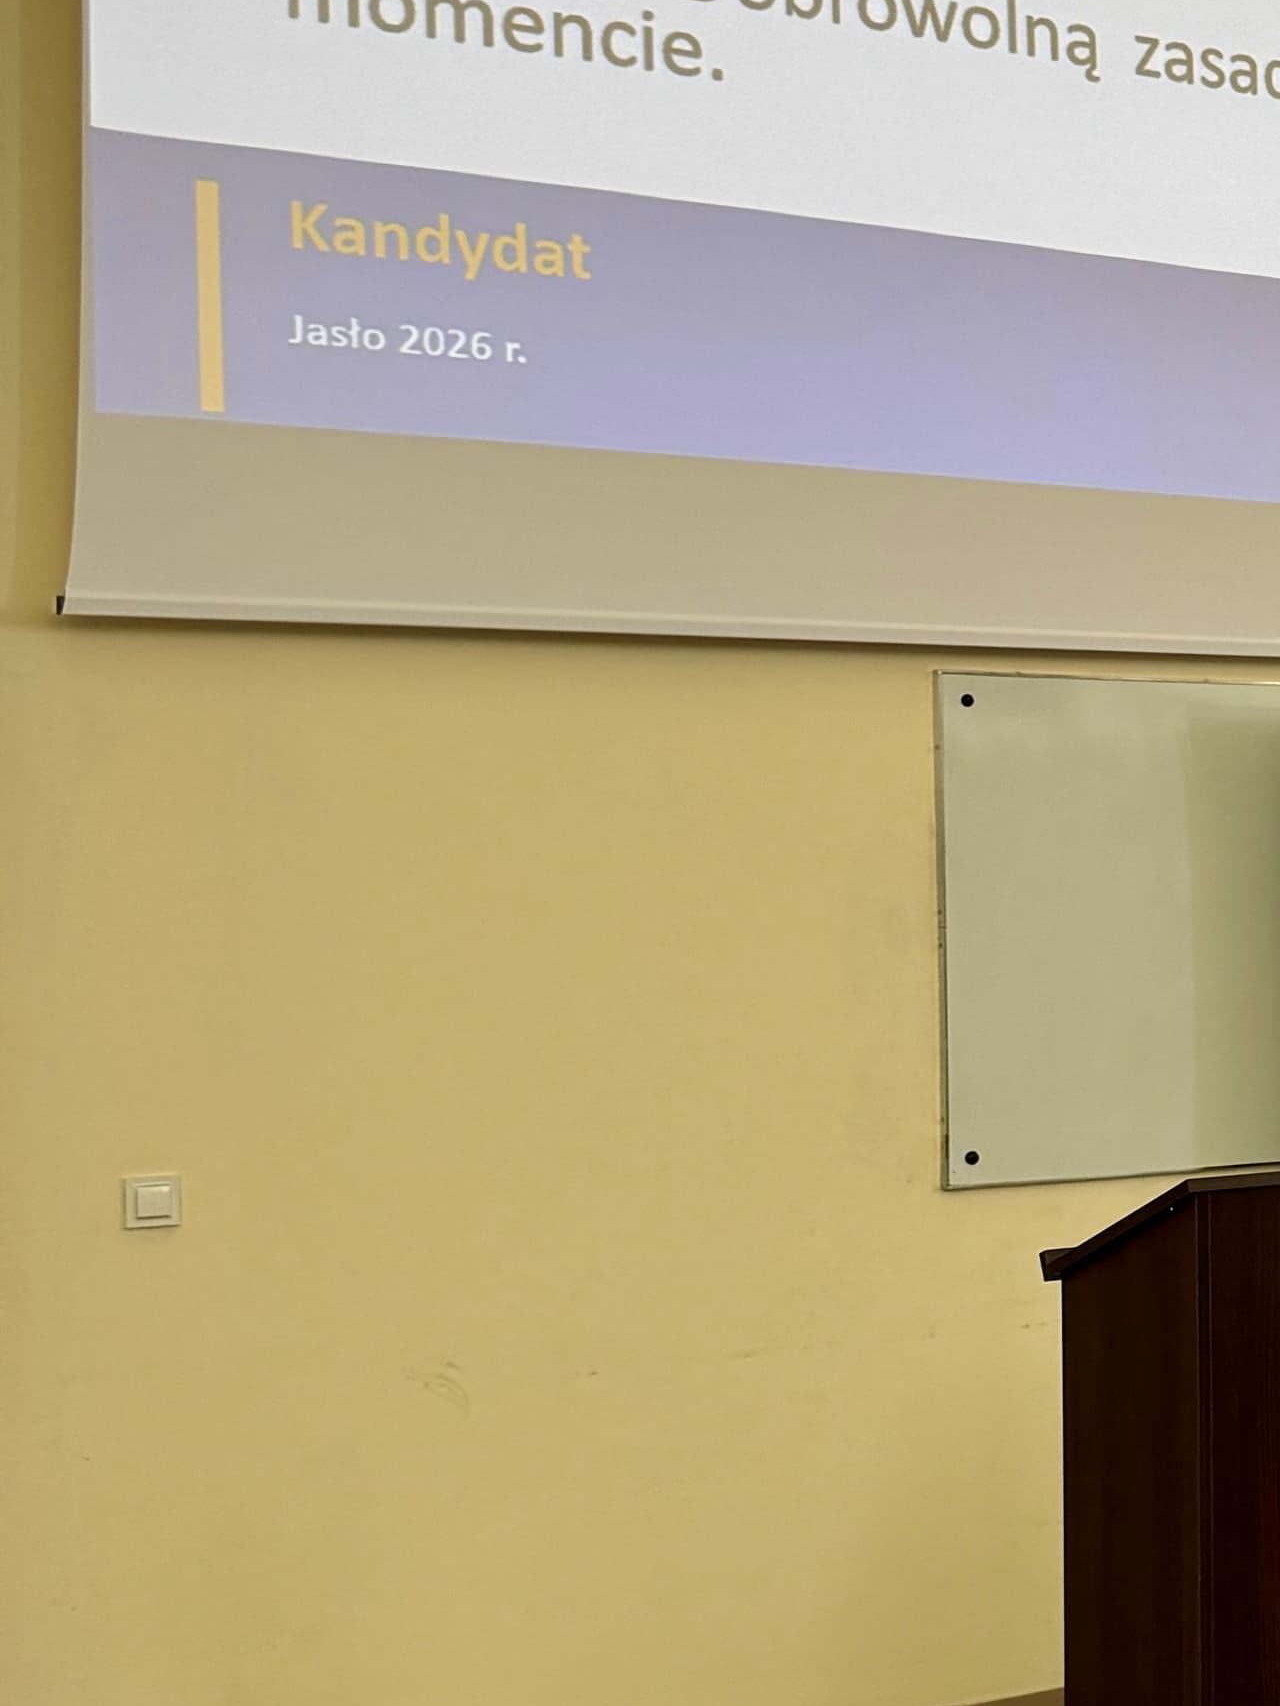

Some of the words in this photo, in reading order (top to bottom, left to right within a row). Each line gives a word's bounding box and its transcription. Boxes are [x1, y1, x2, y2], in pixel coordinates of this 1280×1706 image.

[290, 199, 592, 281] Kandydat
[288, 314, 387, 351] Jasło
[399, 323, 493, 361] 2026
[505, 340, 528, 364] r.
